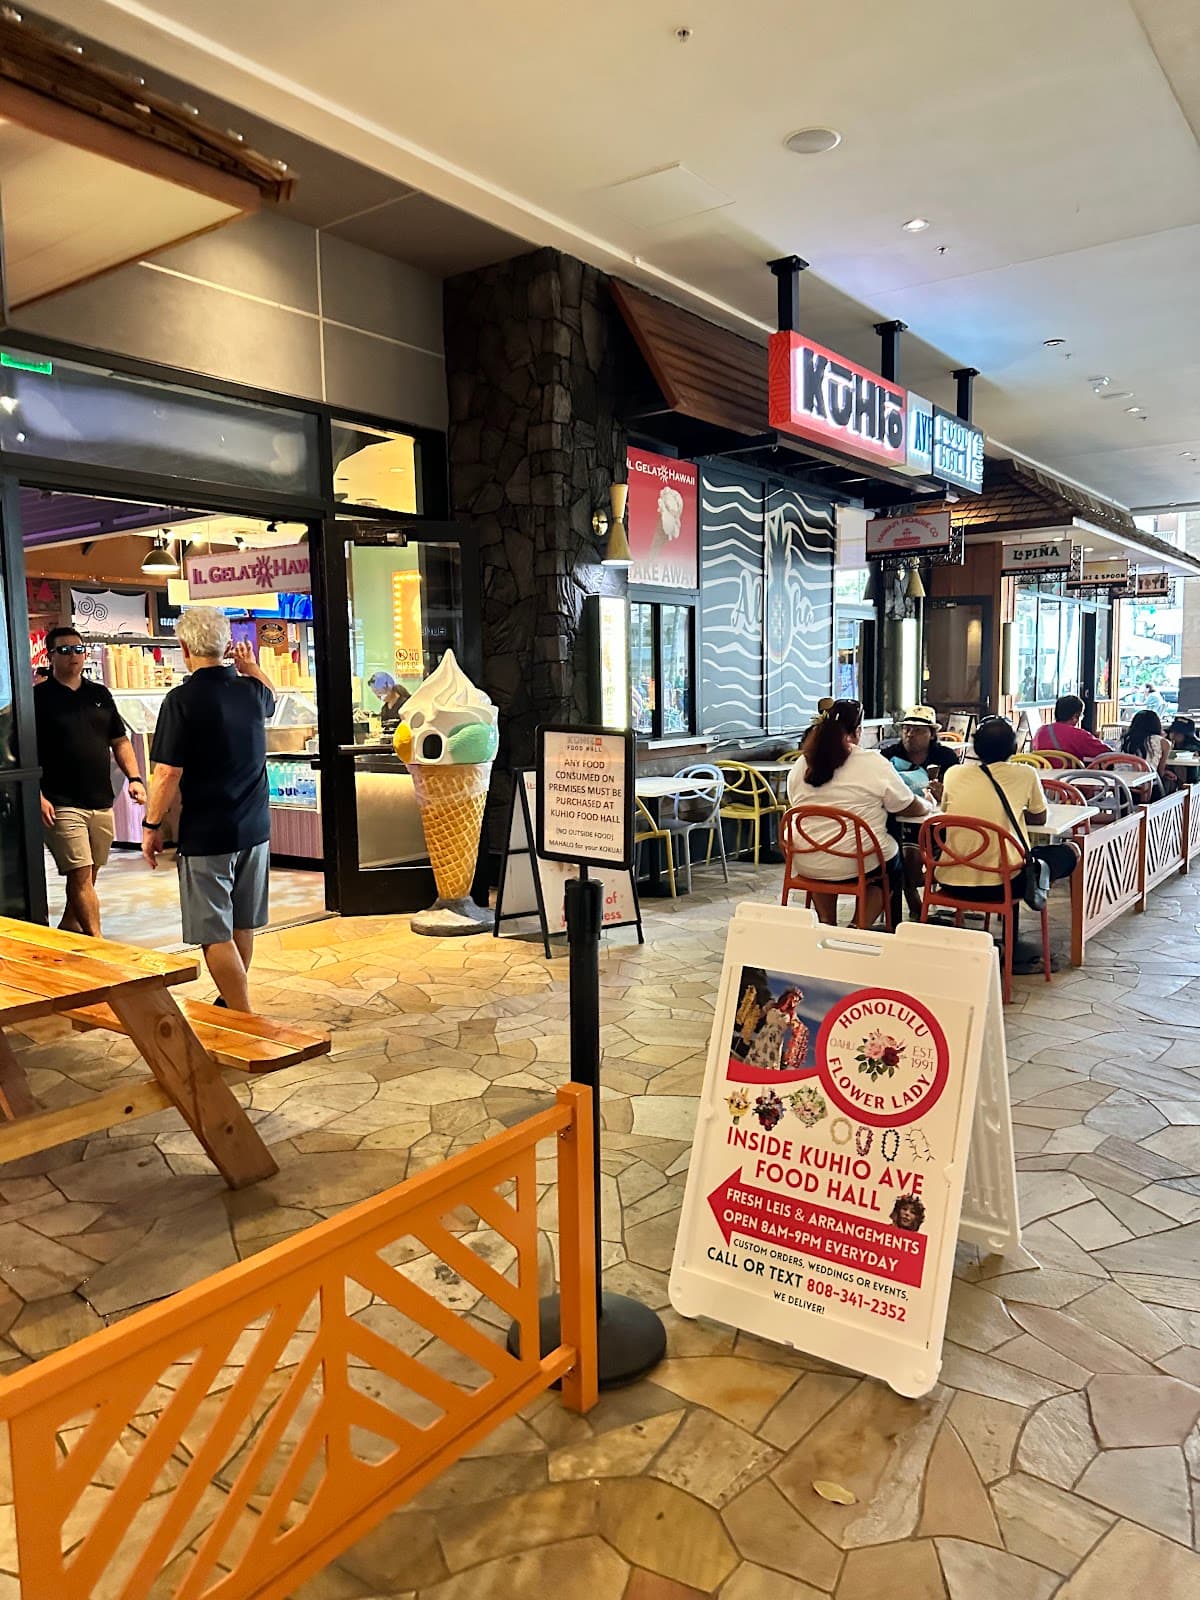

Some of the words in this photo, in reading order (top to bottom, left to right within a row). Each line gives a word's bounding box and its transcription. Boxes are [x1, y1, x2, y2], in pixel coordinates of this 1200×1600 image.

[635, 460, 668, 483] GELATO
[668, 469, 695, 486] HAWAII
[1025, 545, 1060, 560] PIÑA
[209, 556, 274, 588] GELATO
[273, 558, 310, 576] HAW
[629, 563, 659, 580] AKE
[564, 759, 580, 767] ANY
[582, 760, 605, 769] FOOD
[555, 770, 600, 782] CONSUMED
[602, 774, 615, 783] ON
[548, 783, 586, 794] PREMISES
[587, 786, 611, 796] MUST
[612, 788, 622, 797] BE
[556, 796, 601, 808] PURCHASED
[603, 801, 615, 810] AT
[550, 808, 575, 819] KUHIO
[577, 811, 598, 821] FOOD
[600, 814, 621, 823] HALL
[568, 829, 593, 838] OUTSIDE
[548, 839, 574, 848] MAHALO
[606, 891, 617, 904] of
[839, 1002, 929, 1037] HONOLULU
[829, 1038, 855, 1051] OAHU
[911, 1058, 934, 1072] 1991
[829, 1057, 885, 1109] FLOWER
[891, 1074, 930, 1109] LADY
[727, 1126, 793, 1161] INSIDE
[800, 1145, 871, 1180] KUHIO
[878, 1166, 924, 1195] AVE
[755, 1159, 819, 1193] FOOD
[827, 1179, 881, 1211] HALL
[726, 1187, 763, 1210] FRESH
[766, 1198, 791, 1218] LEIS
[794, 1208, 805, 1221] &
[808, 1212, 920, 1255] ARRANGEMENTS
[723, 1209, 758, 1230] OPEN
[761, 1219, 822, 1250] 8AM-9PM
[825, 1239, 899, 1273] EVERYDAY
[733, 1238, 767, 1257] CUSTOM
[769, 1250, 805, 1269] ORDERS,
[808, 1260, 854, 1283] WEDDINGS
[856, 1277, 871, 1288] OR
[873, 1281, 909, 1301] EVENTS,
[707, 1246, 738, 1268] CALL
[743, 1258, 765, 1276] OR
[769, 1265, 804, 1289] TEXT
[807, 1278, 906, 1322] 808-341-2352
[773, 1289, 787, 1303] WE
[788, 1296, 825, 1315] DELIVER!
